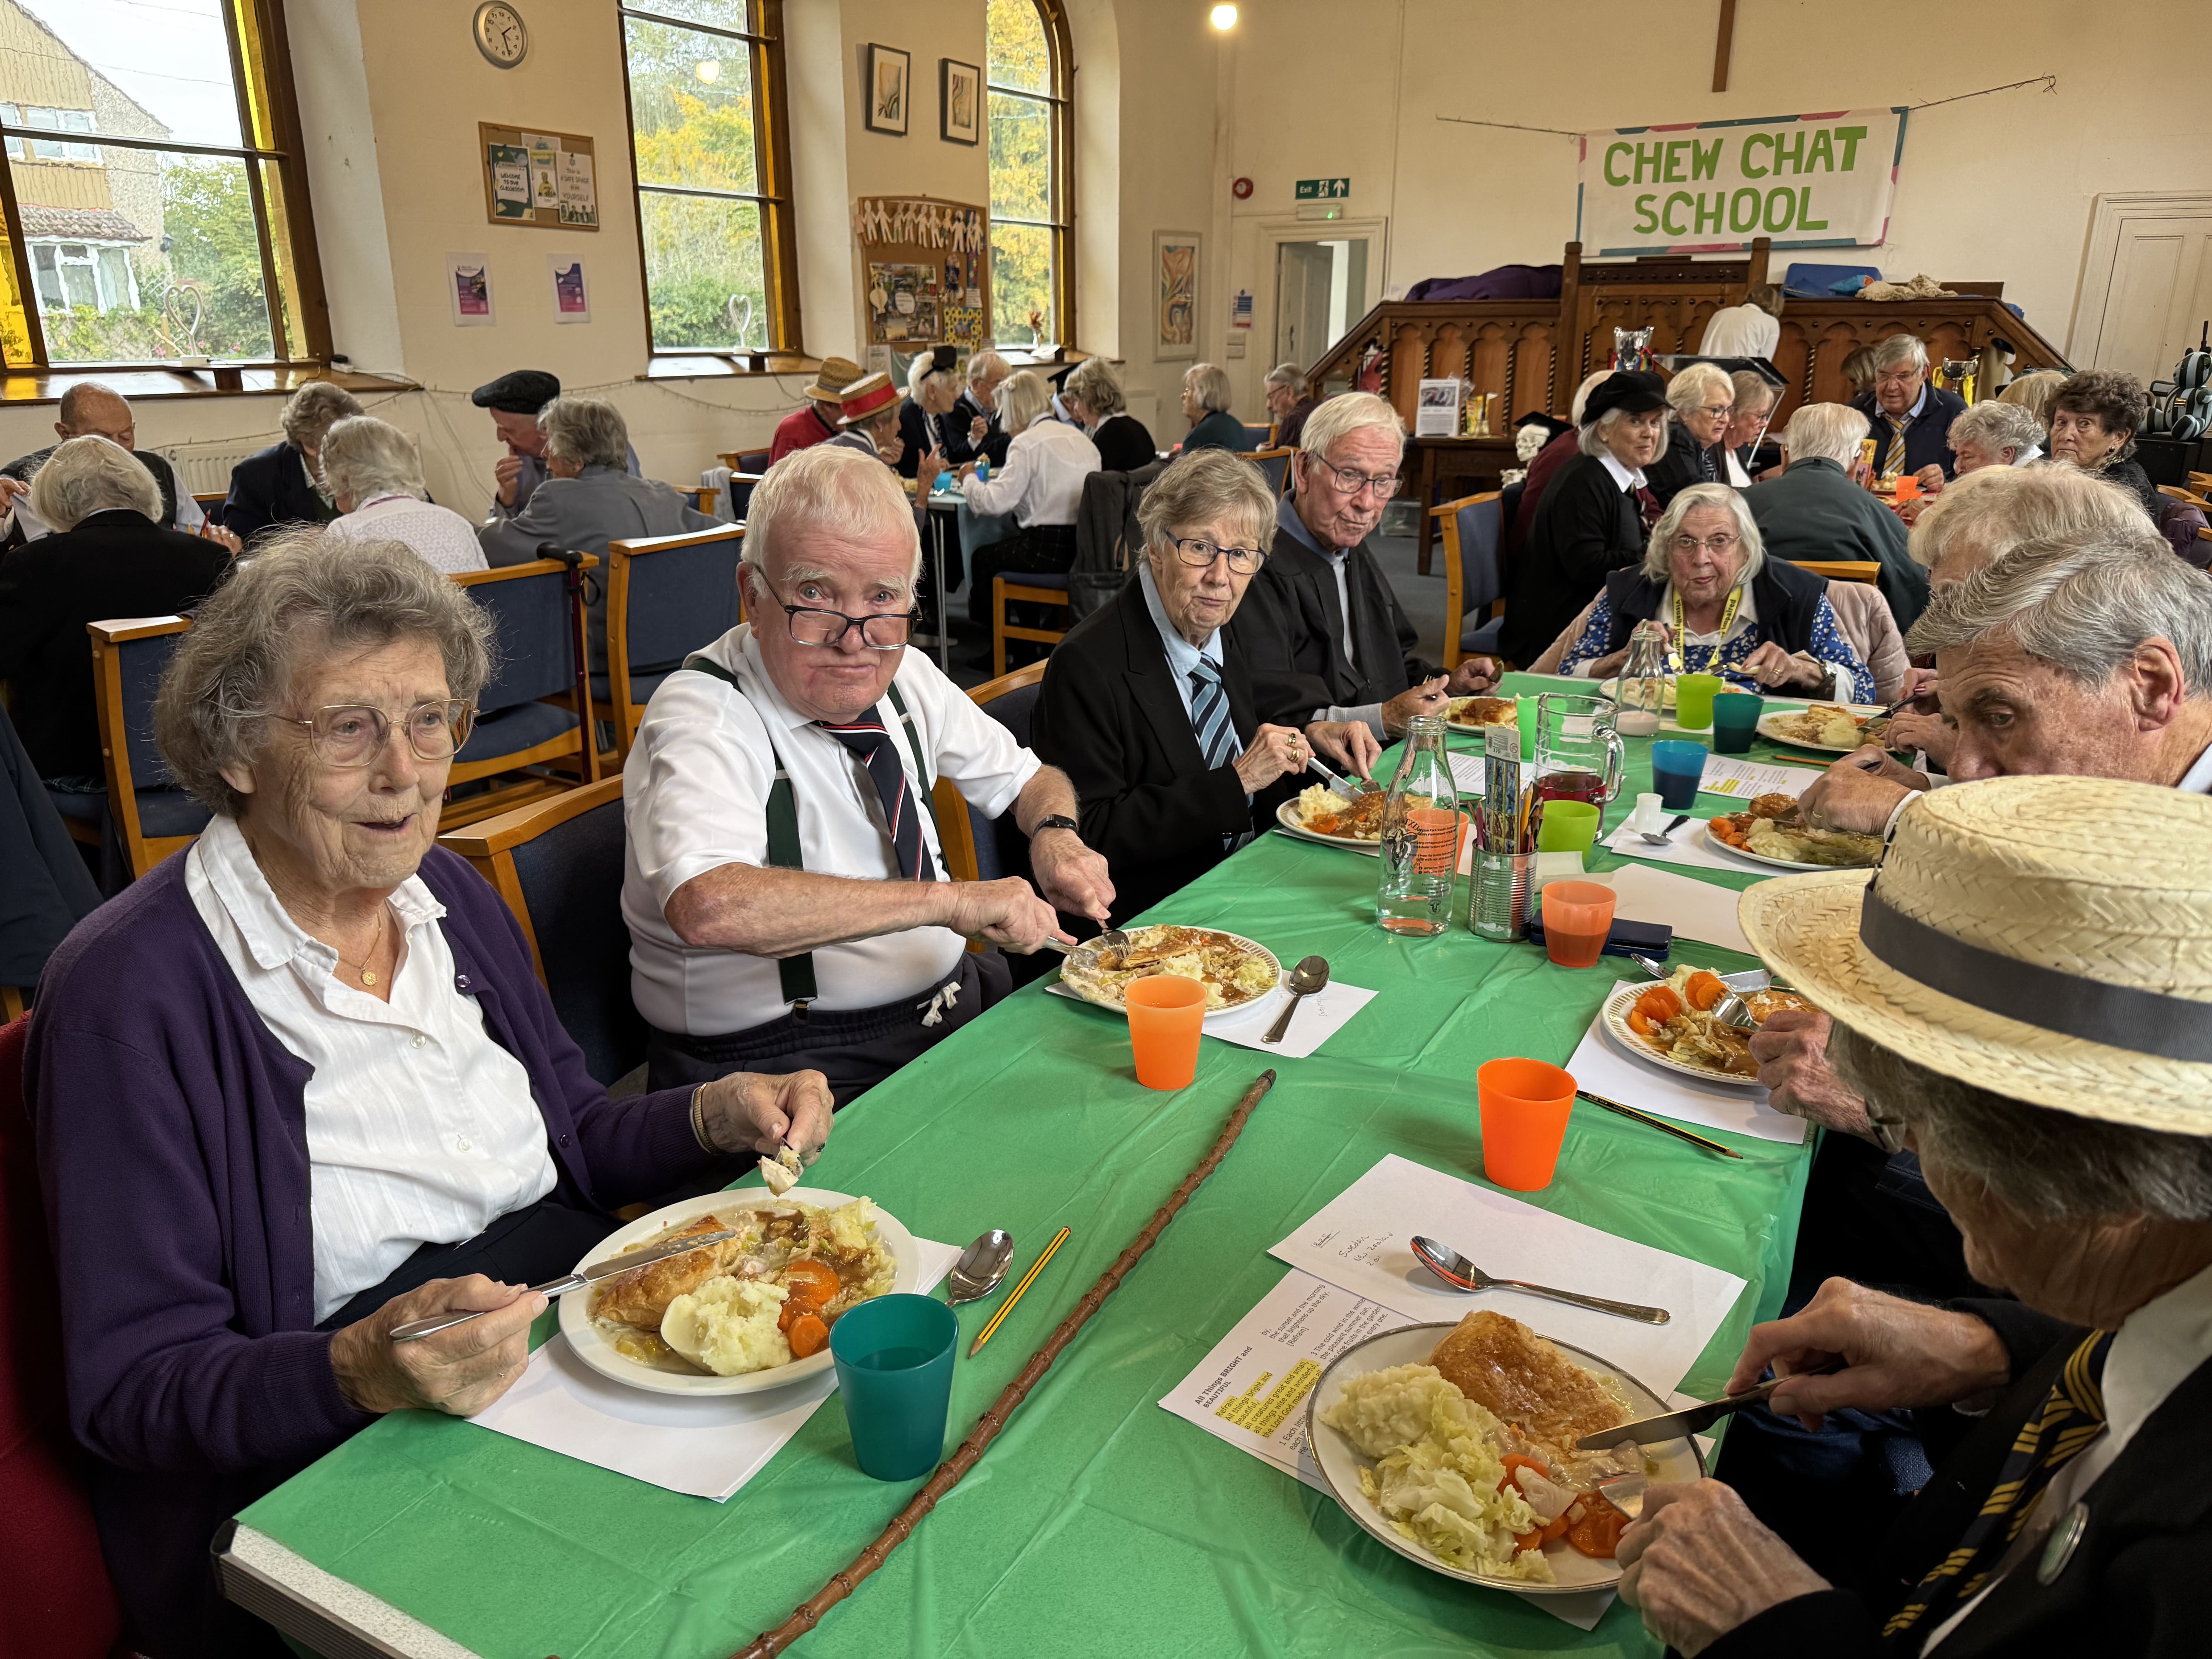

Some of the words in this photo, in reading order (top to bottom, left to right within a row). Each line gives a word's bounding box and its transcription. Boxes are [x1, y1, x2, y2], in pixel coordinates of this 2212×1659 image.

[1604, 138, 1724, 187] CHEW
[1740, 126, 1867, 179] CHAT
[562, 193, 589, 201] YOURSELF
[1633, 186, 1828, 236] SCHOOL
[1721, 599, 1736, 629] Impaired
[1339, 1236, 1369, 1257] Sweden
[1353, 1252, 1368, 1262] New
[1278, 1317, 1293, 1331] sunset
[1291, 1308, 1301, 1317] and
[1306, 1284, 1325, 1301] morning
[1278, 1333, 1290, 1342] that
[1286, 1313, 1308, 1333] brightens
[1319, 1291, 1329, 1300] sky.
[1286, 1326, 1309, 1346] [Refrain]
[1313, 1343, 1326, 1351] The
[1323, 1333, 1334, 1343] cold
[1332, 1322, 1343, 1333] wind
[1319, 1351, 1330, 1359] the
[1328, 1333, 1347, 1352] pleasant
[1344, 1315, 1361, 1333] summer
[1360, 1307, 1371, 1316] sun,
[1366, 1322, 1380, 1334] every
[1377, 1314, 1388, 1322] one.
[1343, 1333, 1358, 1345] fruits
[1195, 1395, 1205, 1405] All
[1202, 1377, 1223, 1395] Things
[1220, 1356, 1242, 1377] BRIGHT
[1241, 1346, 1252, 1356] and
[1203, 1381, 1231, 1408] BEAUTIFUL
[1225, 1413, 1235, 1421] All
[1231, 1397, 1249, 1413] things
[1246, 1381, 1264, 1397] bright
[1261, 1372, 1272, 1382] and
[1251, 1398, 1274, 1422] creatures
[1272, 1384, 1286, 1398] great
[1284, 1374, 1295, 1384] and
[1293, 1361, 1309, 1374] small,
[1254, 1425, 1262, 1434] all
[1259, 1410, 1277, 1426] things
[1274, 1398, 1287, 1409] wise
[1285, 1387, 1296, 1398] and
[1294, 1364, 1319, 1387] wonderful,
[1215, 1396, 1237, 1417] Refrain:
[1233, 1401, 1260, 1425] beautiful,
[1262, 1428, 1274, 1437] the
[1270, 1415, 1285, 1428] Lord
[1281, 1403, 1294, 1415] God
[1291, 1390, 1307, 1404] made
[1303, 1377, 1317, 1390] them
[1282, 1427, 1297, 1441] Each
[1289, 1437, 1303, 1450] each
[1298, 1446, 1308, 1455] He
